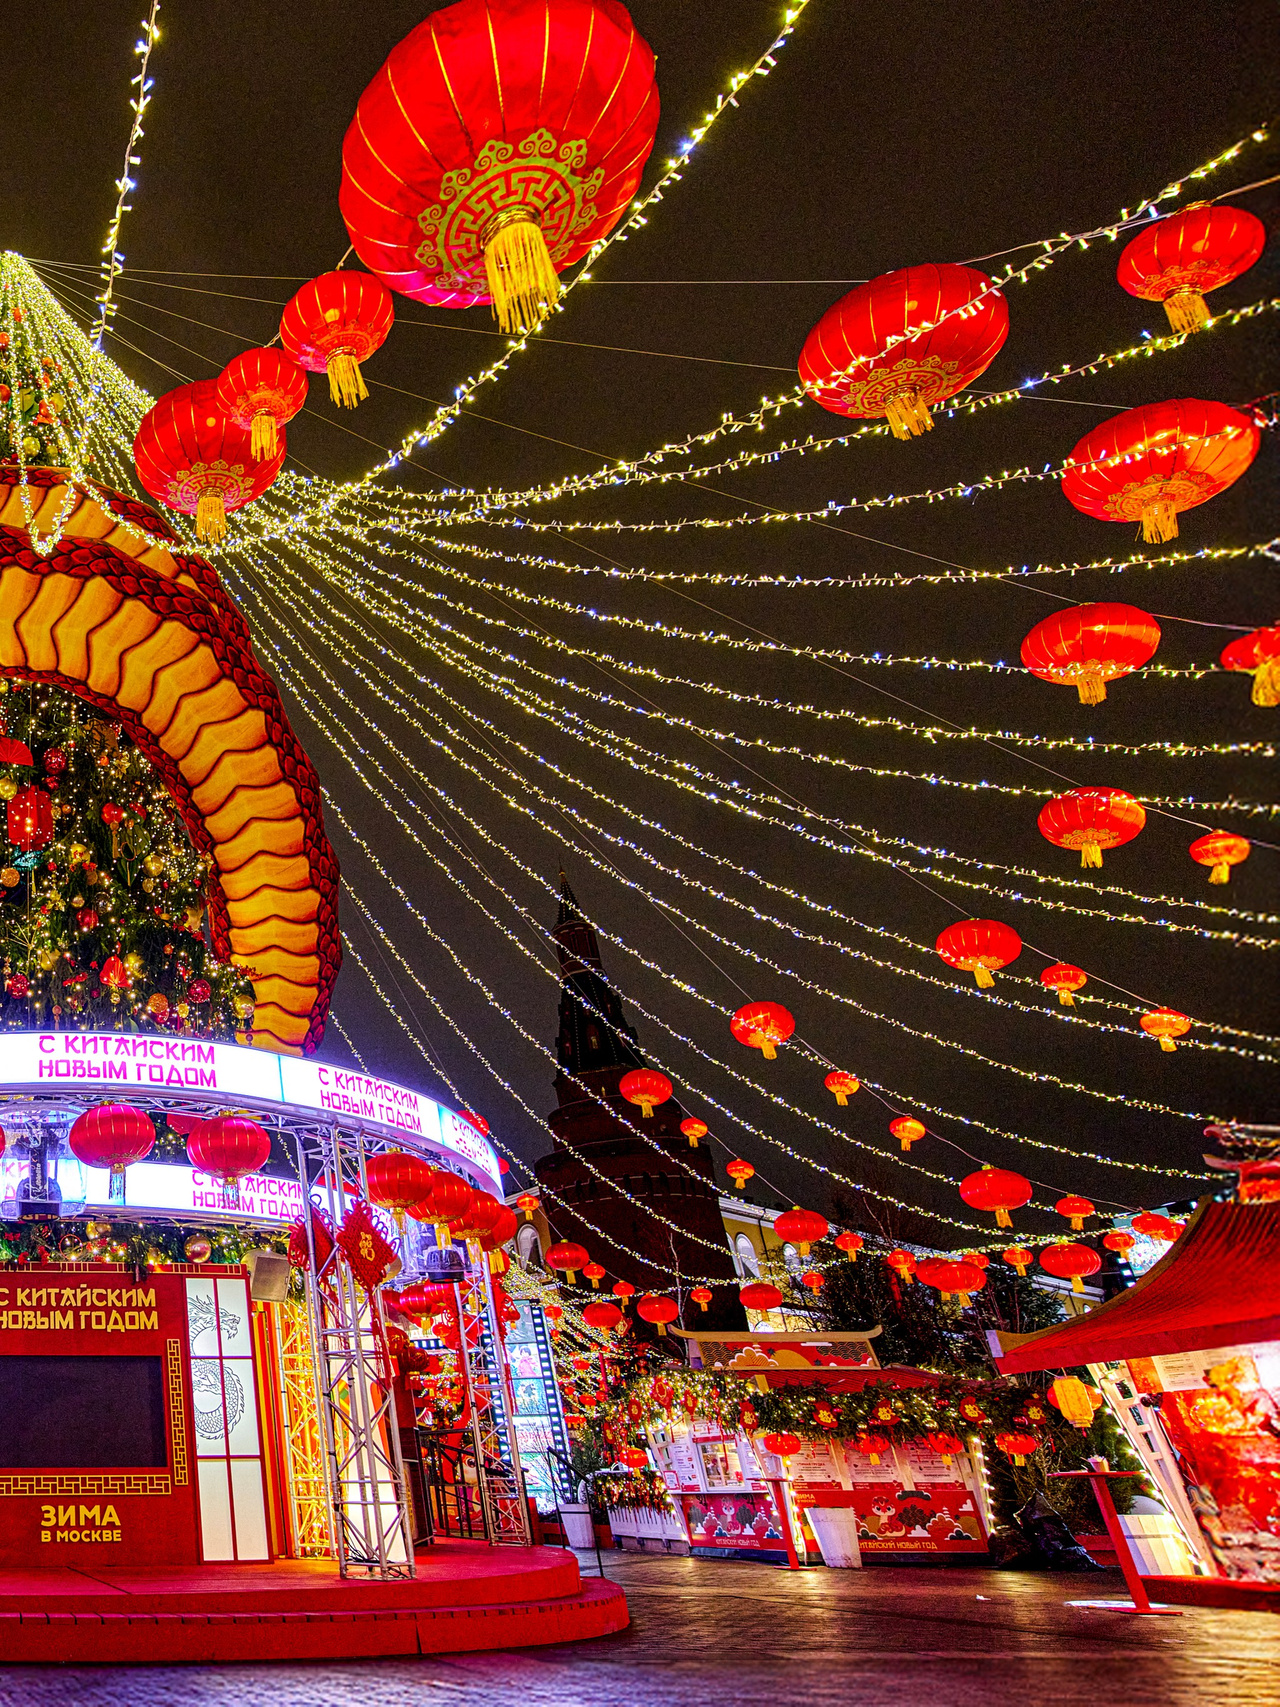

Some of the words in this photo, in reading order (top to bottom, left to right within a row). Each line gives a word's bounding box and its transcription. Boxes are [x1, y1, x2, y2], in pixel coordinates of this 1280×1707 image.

[39, 1035, 55, 1053] С
[65, 1034, 215, 1064] КИТАЙСКИМ
[39, 1059, 127, 1080] НОВЫМ
[136, 1063, 217, 1088] ГОДОМ
[318, 1067, 329, 1086] С
[334, 1071, 420, 1113] КИТАЙСКИМ
[320, 1089, 376, 1119] НОВЫМ
[378, 1103, 423, 1134] ГОДОМ
[192, 1169, 204, 1186] С
[17, 1284, 156, 1307] КИТАЙСКИМ
[79, 1310, 159, 1332] ГОДОМ
[41, 1504, 121, 1527] ЗИМА
[41, 1530, 52, 1542] В
[56, 1529, 122, 1543] МОСКВЕ
[858, 1540, 896, 1550] ИТАЙСКИЙ
[897, 1540, 922, 1550] НОВЫЙ
[922, 1541, 938, 1550] ГОД
